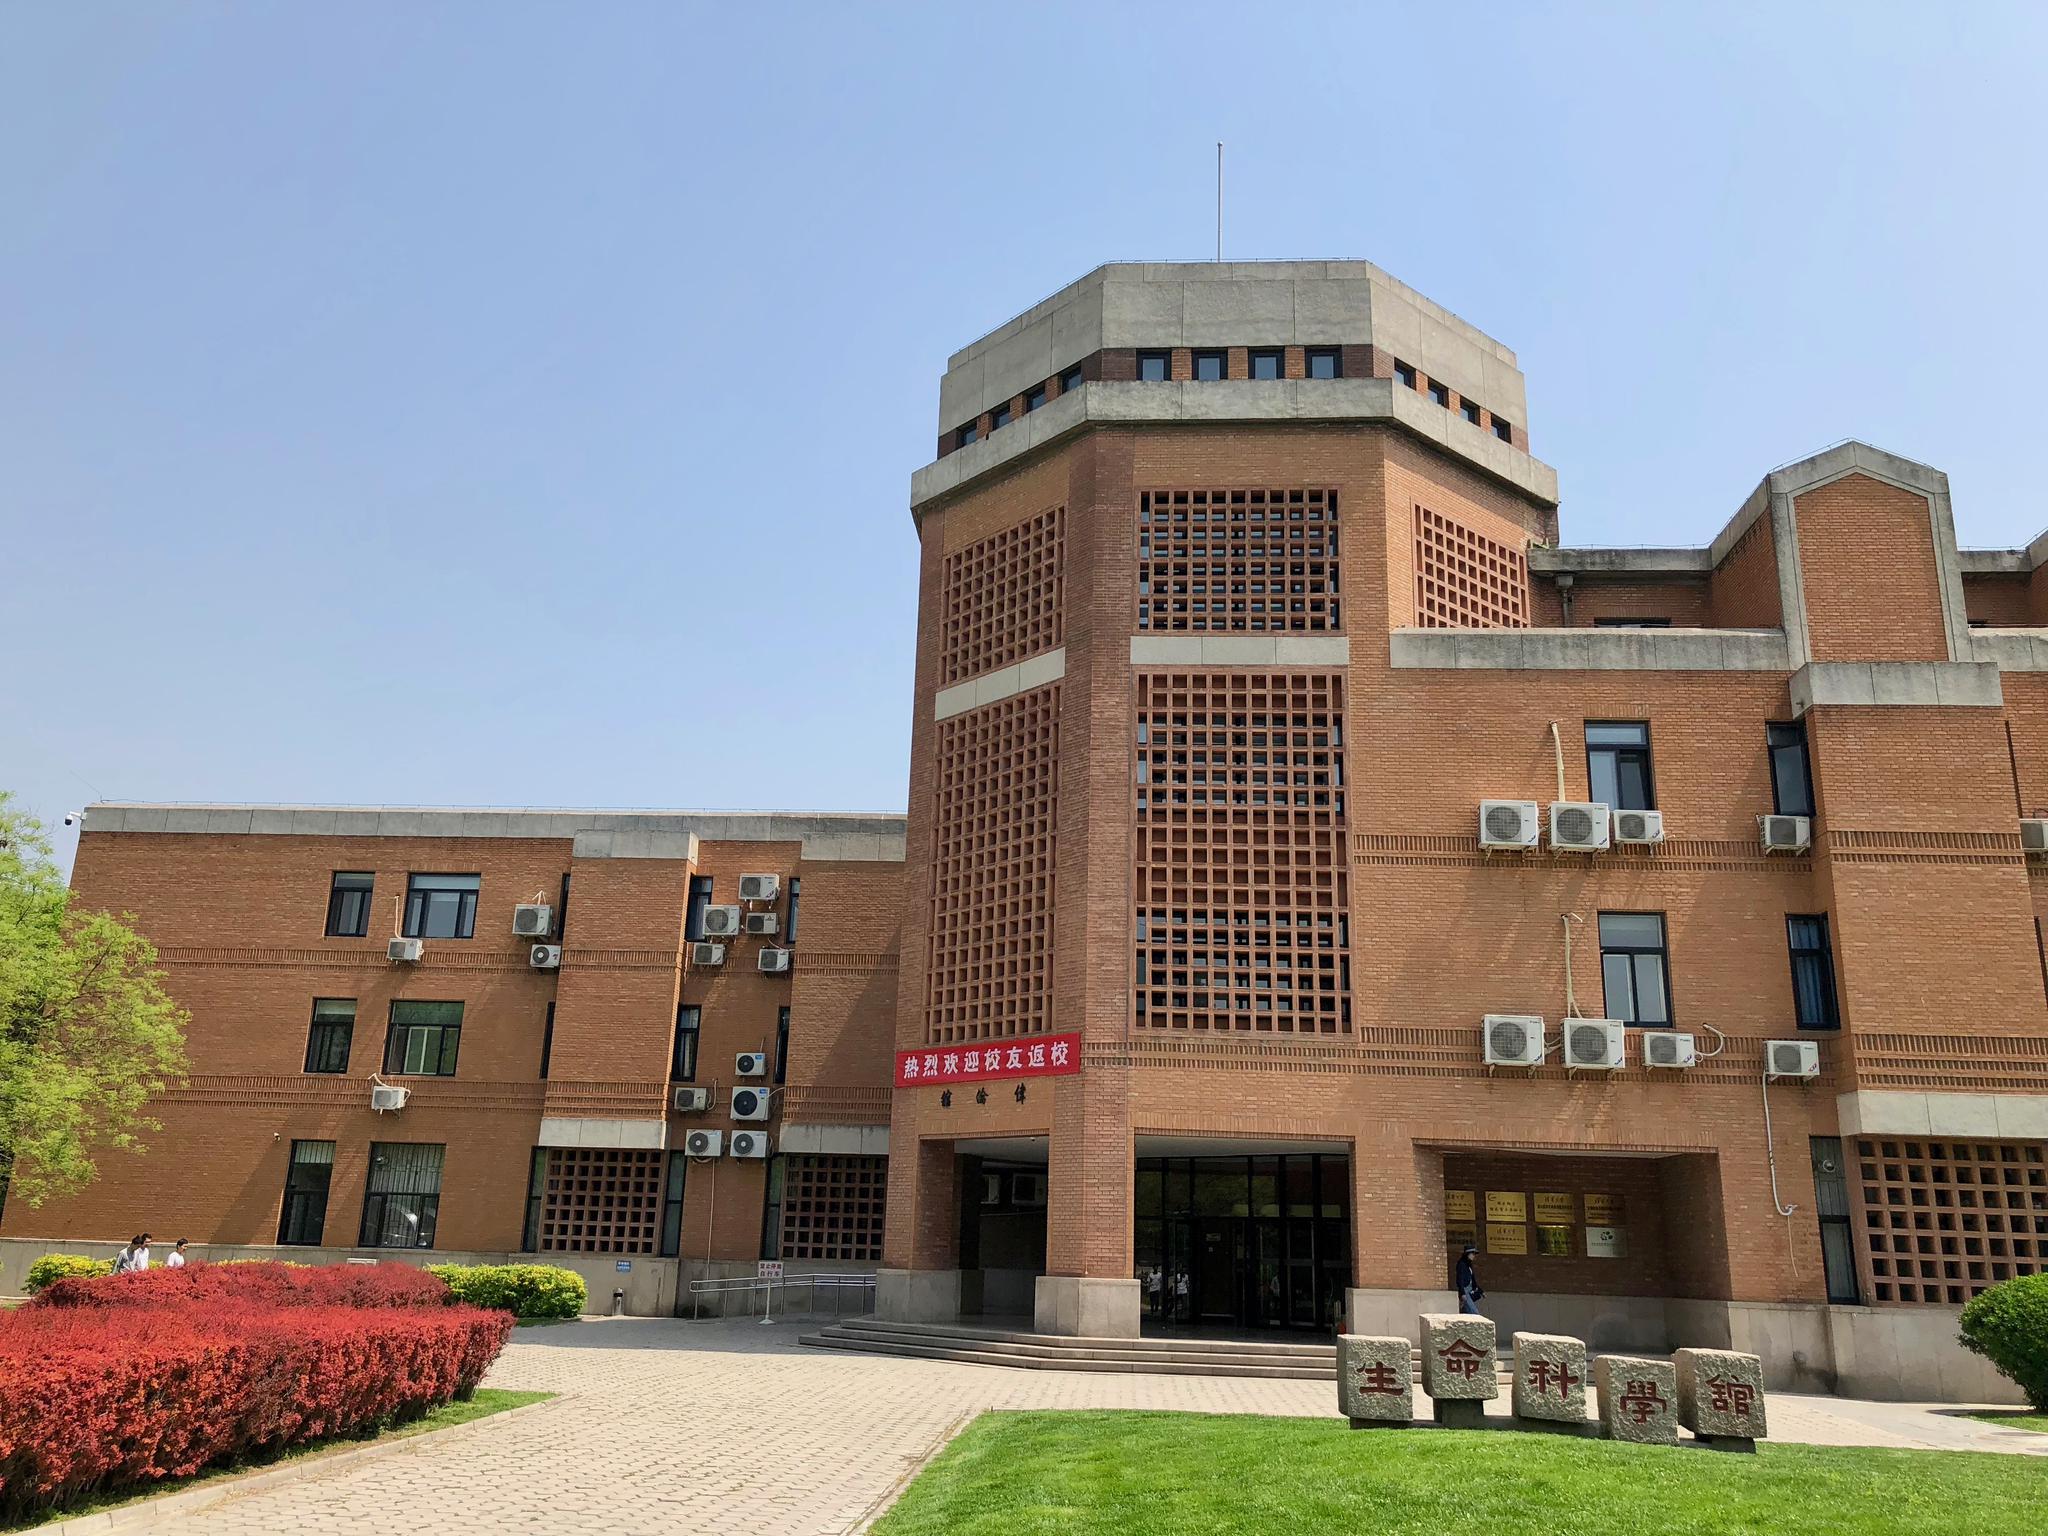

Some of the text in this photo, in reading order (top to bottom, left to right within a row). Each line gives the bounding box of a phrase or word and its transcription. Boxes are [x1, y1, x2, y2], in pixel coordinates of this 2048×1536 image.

[904, 1041, 1069, 1079] 热烈欢迎校友返校
